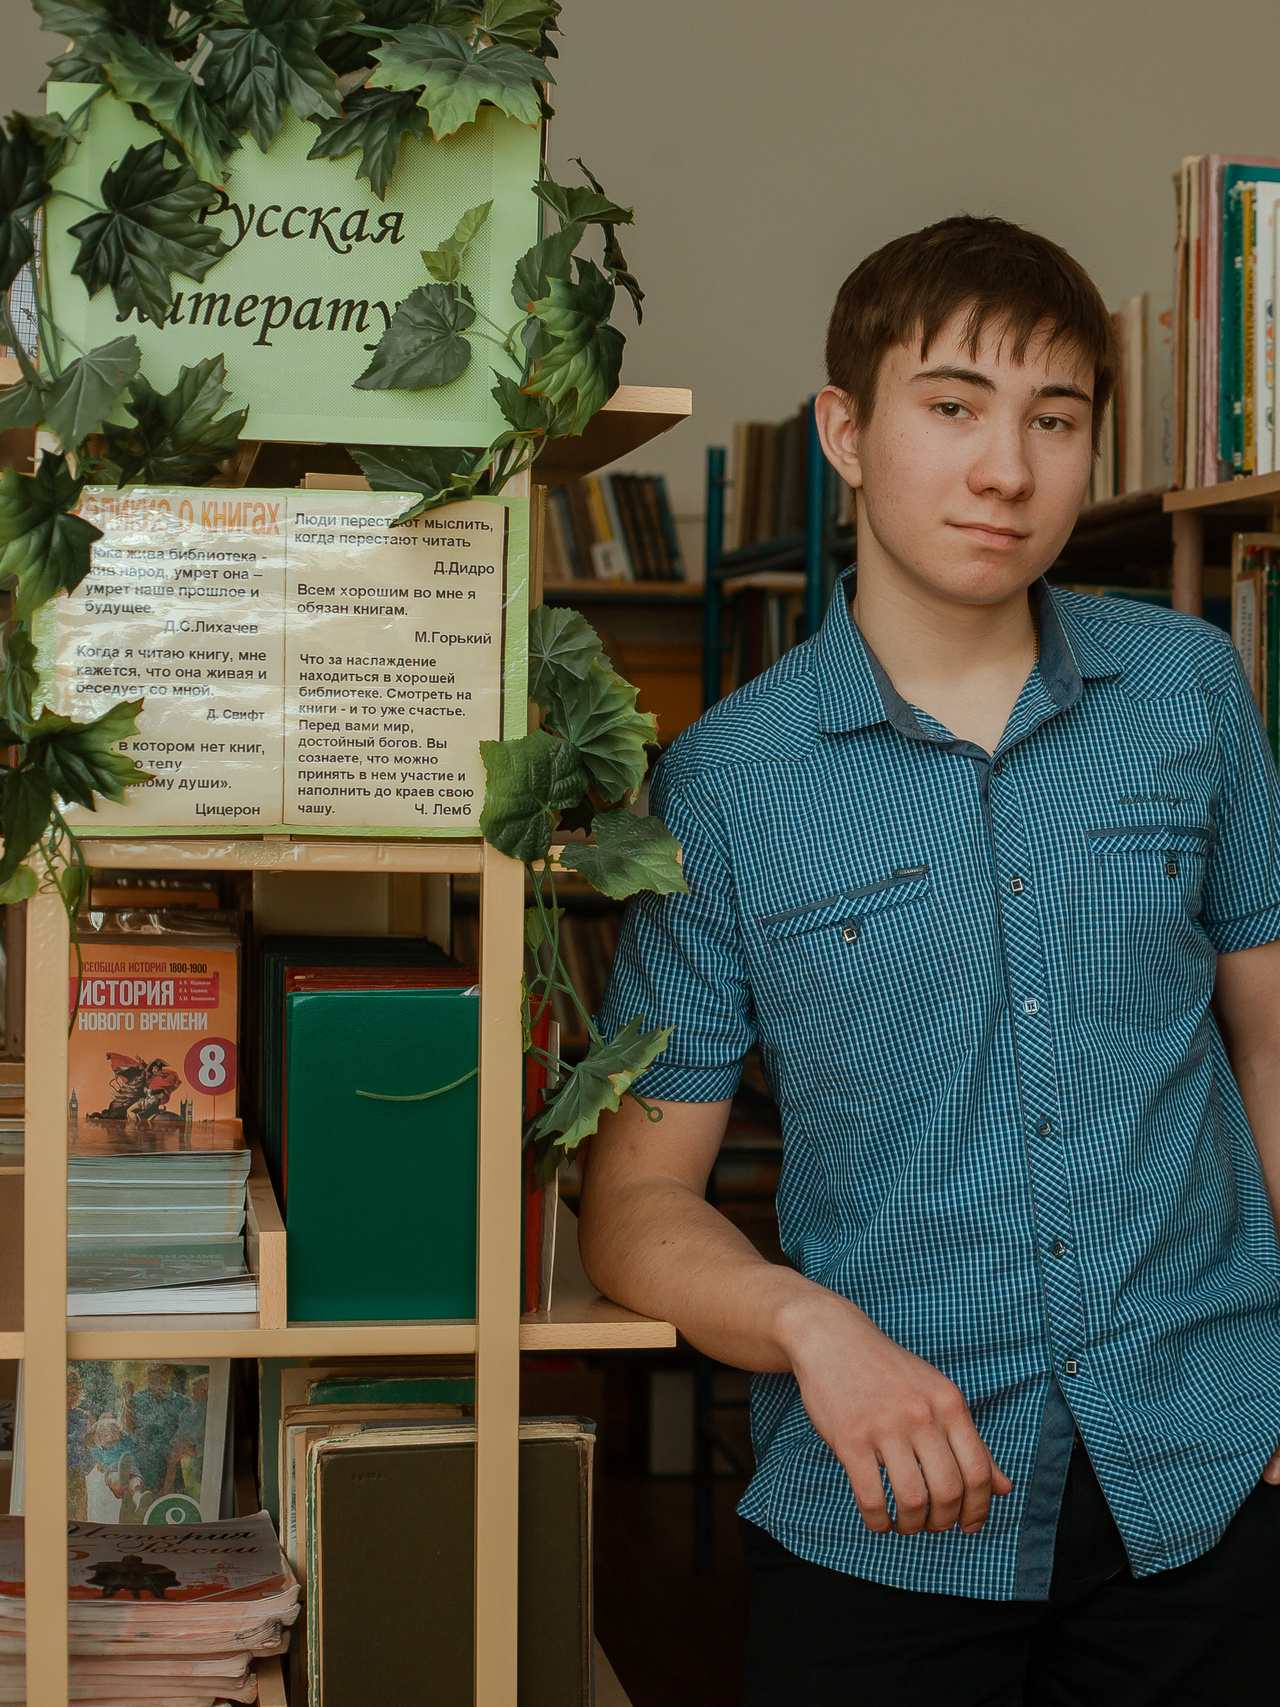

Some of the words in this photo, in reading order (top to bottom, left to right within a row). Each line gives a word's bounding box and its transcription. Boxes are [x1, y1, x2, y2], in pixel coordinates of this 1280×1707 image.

[178, 498, 194, 532] о
[201, 500, 281, 535] книгах
[294, 512, 337, 527] Люди
[424, 518, 494, 533] мыслить,
[294, 532, 335, 545] когда
[339, 533, 419, 548] перестают
[422, 536, 471, 548] читать
[169, 547, 257, 562] библиотека
[174, 569, 219, 580] умрет
[223, 569, 249, 580] она
[433, 561, 495, 577] Д.Дидро
[85, 584, 130, 596] умрет
[135, 584, 174, 595] наше
[178, 586, 246, 599] прошлое
[250, 588, 259, 597] и
[297, 584, 335, 596] Всем
[340, 587, 409, 600] хорошим
[413, 589, 432, 598] во
[435, 589, 463, 599] мне
[467, 590, 476, 599] я
[85, 600, 155, 615] будущее.
[297, 602, 349, 614] обязан
[353, 605, 409, 616] книгам.
[414, 631, 492, 646] М.Горький
[76, 645, 120, 660] Когда
[124, 649, 133, 658] я
[138, 649, 184, 659] читаю
[189, 650, 233, 663] книгу,
[238, 651, 267, 661] мне
[299, 654, 324, 665] Что
[328, 656, 342, 665] за
[346, 656, 437, 668] наслаждение
[76, 666, 141, 679] кажется,
[145, 668, 170, 678] что
[175, 668, 201, 679] она
[206, 669, 254, 679] живая
[258, 670, 267, 679] и
[299, 671, 379, 683] находиться
[383, 673, 391, 682] в
[395, 672, 455, 685] хорошей
[76, 682, 145, 696] беседует
[149, 685, 167, 695] со
[172, 684, 215, 696] мной.
[299, 686, 383, 699] библиотеке.
[386, 688, 453, 702] Смотреть
[456, 691, 472, 701] на
[207, 709, 219, 721] Д.
[223, 709, 265, 722] Свифт
[299, 704, 337, 714] книги
[349, 705, 358, 714] и
[361, 706, 377, 715] то
[380, 706, 405, 717] уже
[409, 707, 466, 717] счастье.
[299, 719, 340, 733] Перед
[345, 722, 379, 731] вами
[383, 723, 414, 734] мир,
[119, 741, 128, 751] в
[132, 741, 195, 754] котором
[200, 742, 225, 752] нет
[229, 742, 265, 755] книг,
[298, 735, 375, 748] достойный
[378, 737, 422, 749] богов.
[427, 738, 447, 749] Вы
[148, 759, 183, 773] телу
[298, 754, 363, 765] сознаете,
[367, 755, 389, 764] что
[394, 755, 439, 765] можно
[298, 770, 355, 782] принять
[359, 772, 367, 780] в
[371, 772, 396, 780] нем
[400, 772, 454, 783] участие
[457, 773, 466, 781] и
[178, 778, 232, 791] души».
[298, 786, 371, 796] наполнить
[374, 787, 392, 798] до
[395, 787, 435, 799] краев
[438, 789, 474, 798] свою
[195, 803, 260, 818] Цицерон
[297, 804, 335, 816] чашу.
[414, 804, 428, 815] Ч.
[433, 803, 472, 816] Лемб
[128, 962, 167, 973] ИСТОРИЯ
[168, 963, 208, 974] 1800-1900
[79, 980, 175, 1006] ИСТОРИЯ
[78, 1012, 135, 1031] НОВОГО
[139, 1012, 208, 1031] ВРЕМЕНИ
[198, 1043, 227, 1088] 8
